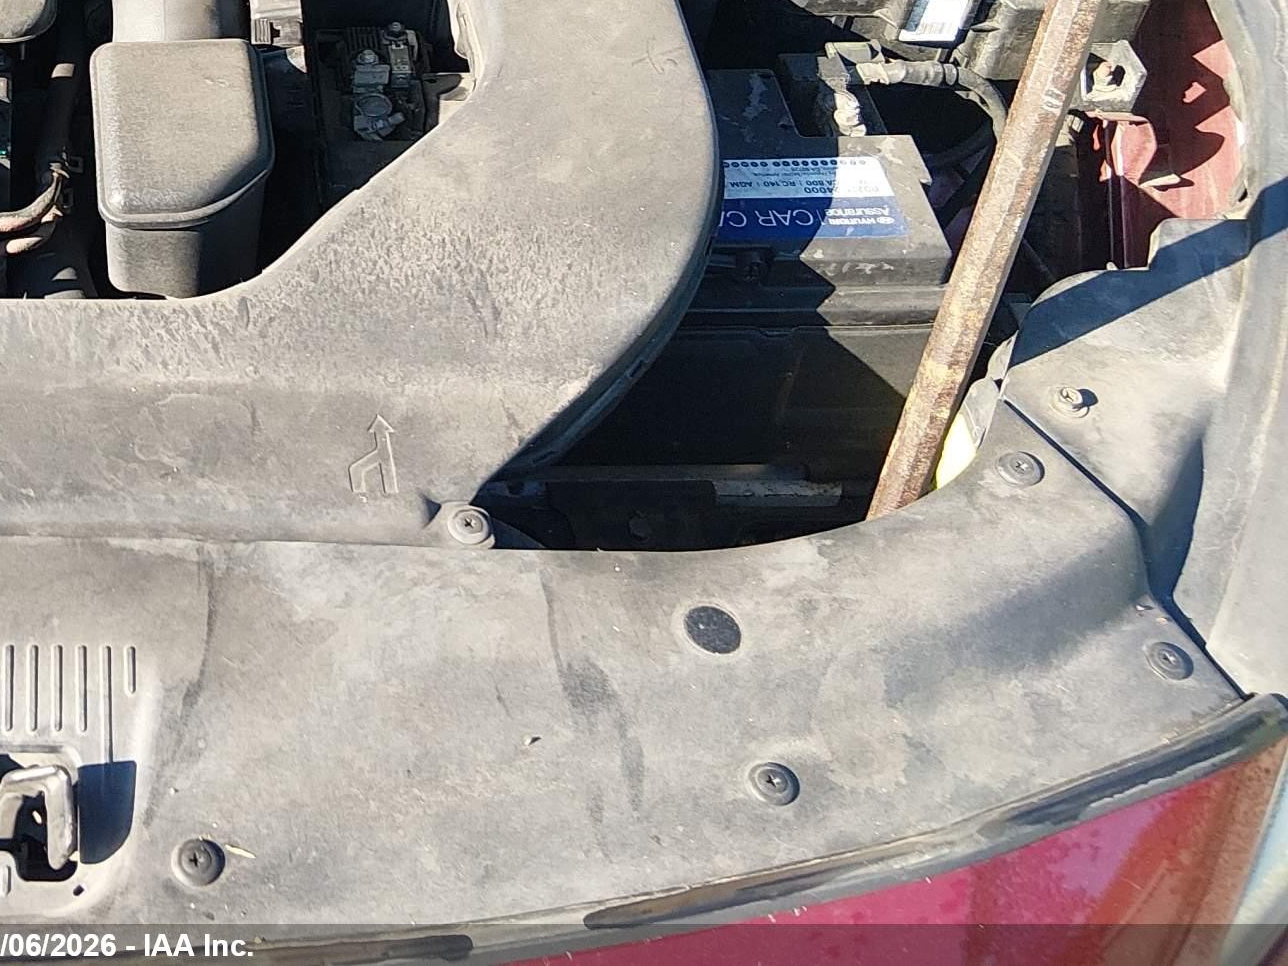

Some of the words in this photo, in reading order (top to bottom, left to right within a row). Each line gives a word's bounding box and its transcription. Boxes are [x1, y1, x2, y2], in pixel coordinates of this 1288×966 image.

[719, 210, 747, 227] C
[754, 209, 814, 226] CAR
[825, 206, 890, 217] Assurance
